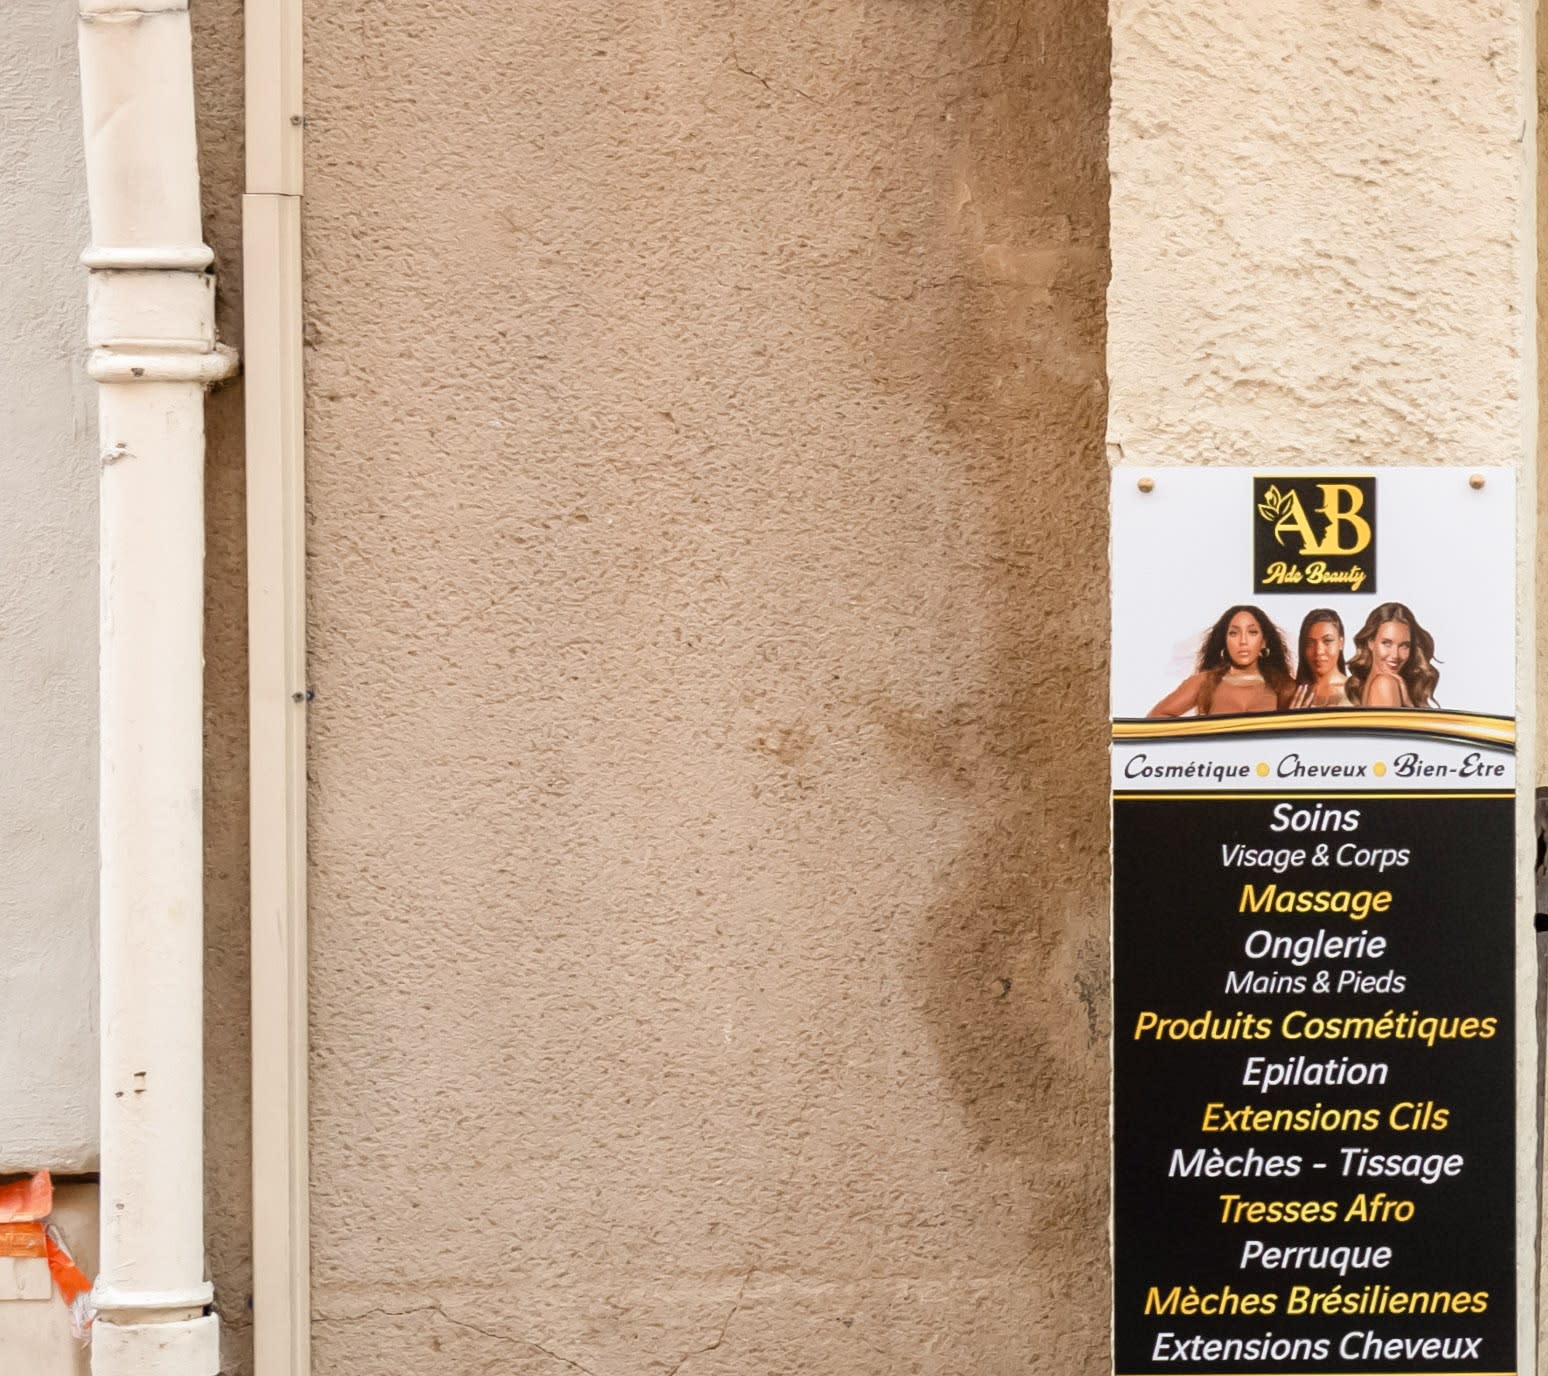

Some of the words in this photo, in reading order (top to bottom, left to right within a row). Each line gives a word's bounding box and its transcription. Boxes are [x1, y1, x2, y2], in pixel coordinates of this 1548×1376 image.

[1275, 483, 1373, 555] AB
[1262, 561, 1303, 585] Ade
[1305, 561, 1366, 591] Beauty
[1124, 753, 1251, 783] Cosmétique
[1276, 753, 1367, 779] Cheveux
[1393, 751, 1506, 778] Bien-Etre
[1269, 802, 1361, 832] Soins
[1222, 843, 1307, 874] Visage
[1311, 843, 1330, 867] &
[1336, 843, 1411, 873] Corps
[1239, 884, 1393, 921] Massage
[1244, 928, 1387, 967] Onglerie
[1224, 970, 1307, 994] Mains
[1312, 970, 1330, 994] &
[1336, 969, 1407, 994] Pieds
[1134, 1010, 1273, 1040] Produits
[1281, 1009, 1498, 1047] Cosmétiques
[1242, 1055, 1389, 1094] Epilation
[1201, 1102, 1381, 1132] Extensions
[1389, 1100, 1450, 1131] Cils
[1168, 1147, 1303, 1178] Mèches
[1340, 1147, 1464, 1185] Tissage
[1219, 1194, 1339, 1224] Tresses
[1343, 1192, 1415, 1222] Afro
[1239, 1240, 1393, 1277] Perruque
[1143, 1285, 1279, 1315] Mèches
[1286, 1284, 1489, 1315] Brésiliennes
[1151, 1331, 1331, 1361] Extensions
[1339, 1330, 1483, 1360] Cheveux
